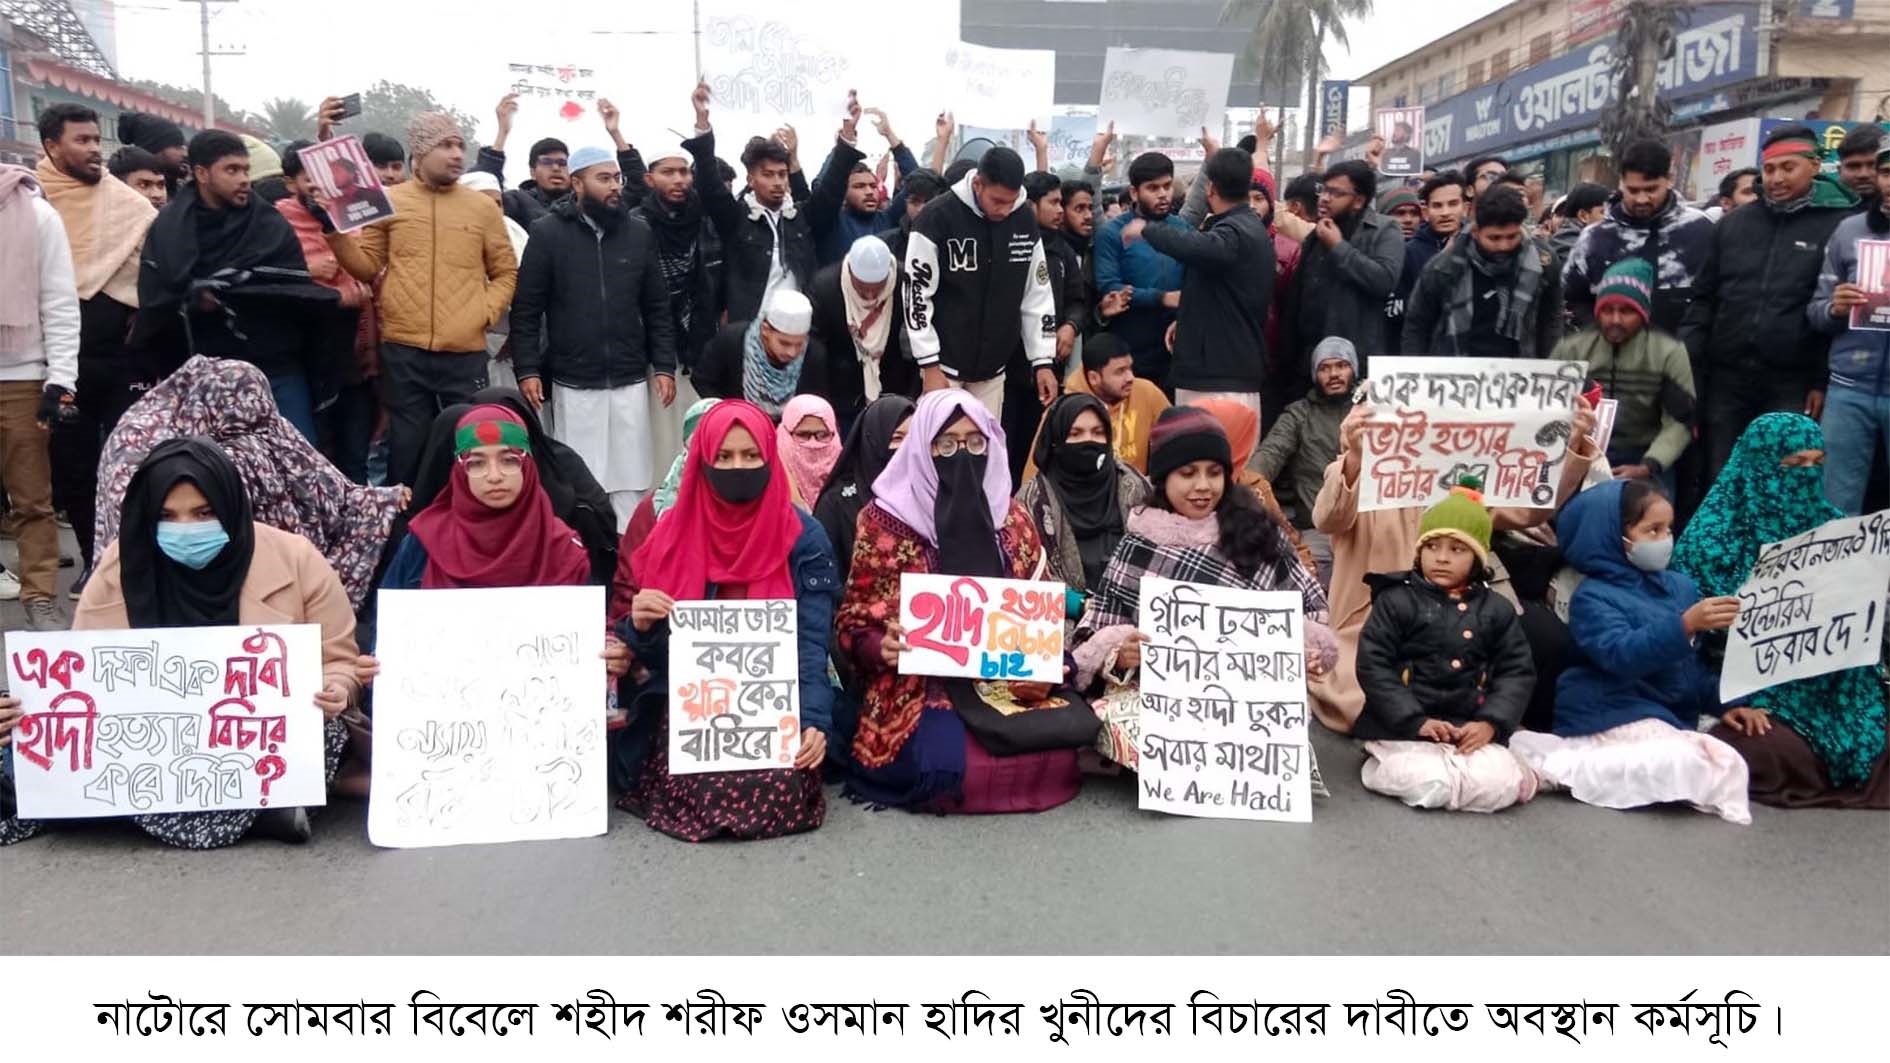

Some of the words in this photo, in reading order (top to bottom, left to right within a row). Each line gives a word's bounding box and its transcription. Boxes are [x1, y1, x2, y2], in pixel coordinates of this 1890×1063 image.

[1514, 44, 1622, 132] ওয়ালট
[947, 238, 978, 271] M
[1371, 372, 1419, 407] এক
[1424, 371, 1484, 410] দফা
[1486, 371, 1528, 408] এক
[1531, 362, 1585, 410] দাবী
[1362, 410, 1428, 457] ভাই
[1430, 422, 1515, 456] হত্যার
[1372, 456, 1438, 503] বিচার
[1494, 448, 1547, 499] দিবি
[671, 604, 741, 634] আমার
[744, 601, 794, 633] ভাই
[906, 577, 988, 667] হাদি
[1001, 588, 1066, 624] হত্যার
[1150, 584, 1210, 636] গুলি
[1216, 605, 1295, 646] ঢুকল
[1737, 580, 1814, 640] ইন্টেরিম
[692, 641, 781, 678] কবরে
[987, 611, 1062, 661] বিচার
[1142, 635, 1220, 682] হাদীর
[1226, 652, 1302, 683] মাথায়
[1751, 626, 1822, 676] জবাব
[1824, 612, 1857, 655] দে
[12, 648, 85, 689] এক
[91, 640, 159, 692] দফা
[159, 656, 219, 698] এক
[224, 628, 290, 698] দাবী
[678, 678, 737, 722] খুনি
[738, 679, 796, 716] কেন
[1141, 692, 1181, 722] আর
[1187, 684, 1238, 726] হাদী
[1246, 701, 1305, 737] ঢুকল
[16, 691, 100, 771] হাদী
[96, 713, 202, 759] হত্যার
[208, 698, 287, 754] বিচার
[679, 713, 778, 762] বাহিরে
[169, 753, 255, 807] দিবি
[1143, 734, 1208, 772] সবার
[1215, 743, 1303, 781] মাথায়
[1144, 779, 1175, 801] We
[1183, 780, 1224, 805] Are
[1230, 780, 1291, 812] Hadi
